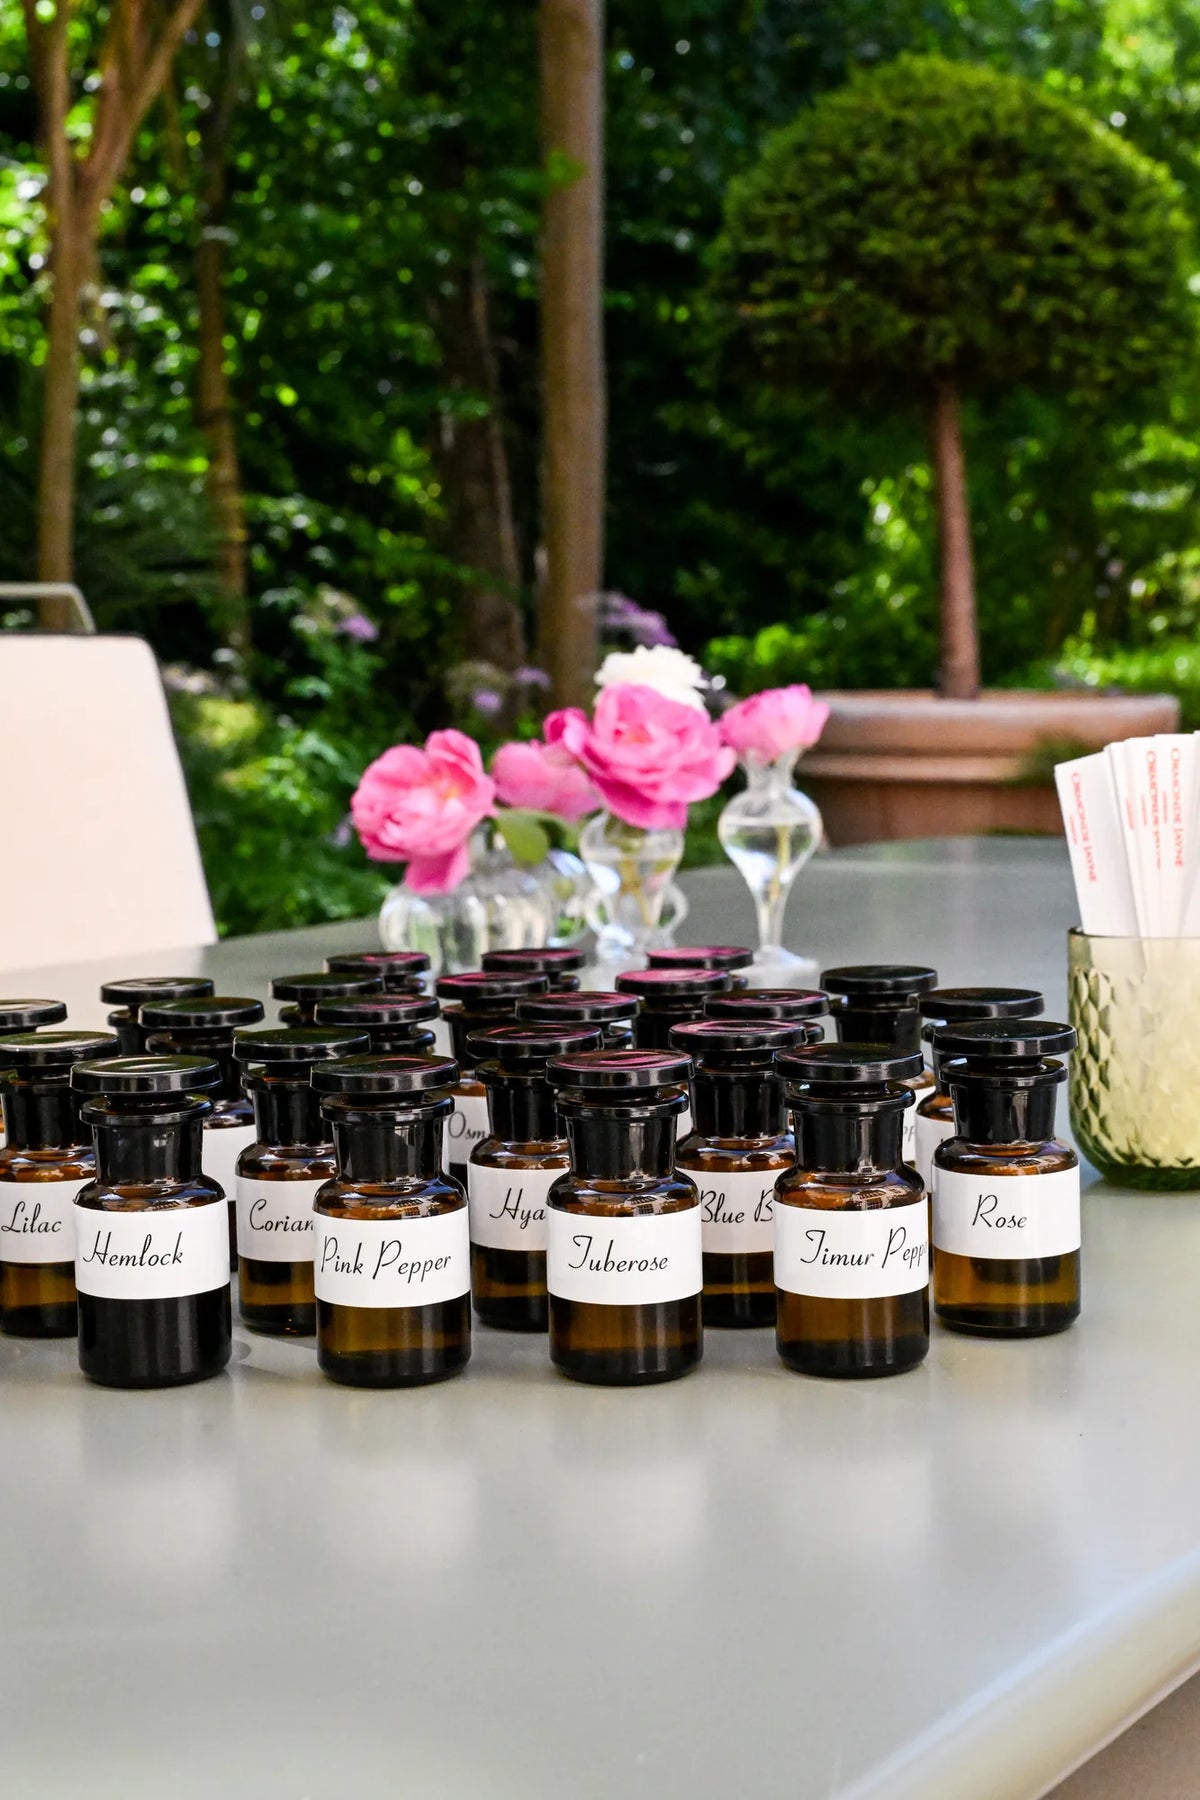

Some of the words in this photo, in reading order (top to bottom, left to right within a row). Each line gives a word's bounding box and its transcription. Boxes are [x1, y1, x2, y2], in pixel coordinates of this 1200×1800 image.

[1, 1202, 62, 1234] Lilac
[489, 1188, 546, 1230] Hya
[701, 1189, 745, 1224] Blue
[971, 1194, 1028, 1229] Rose
[82, 1230, 184, 1267] Hemlock
[320, 1236, 364, 1276] Pink
[371, 1239, 452, 1285] Pepper
[567, 1234, 669, 1274] Tuberose
[800, 1228, 875, 1267] Timur
